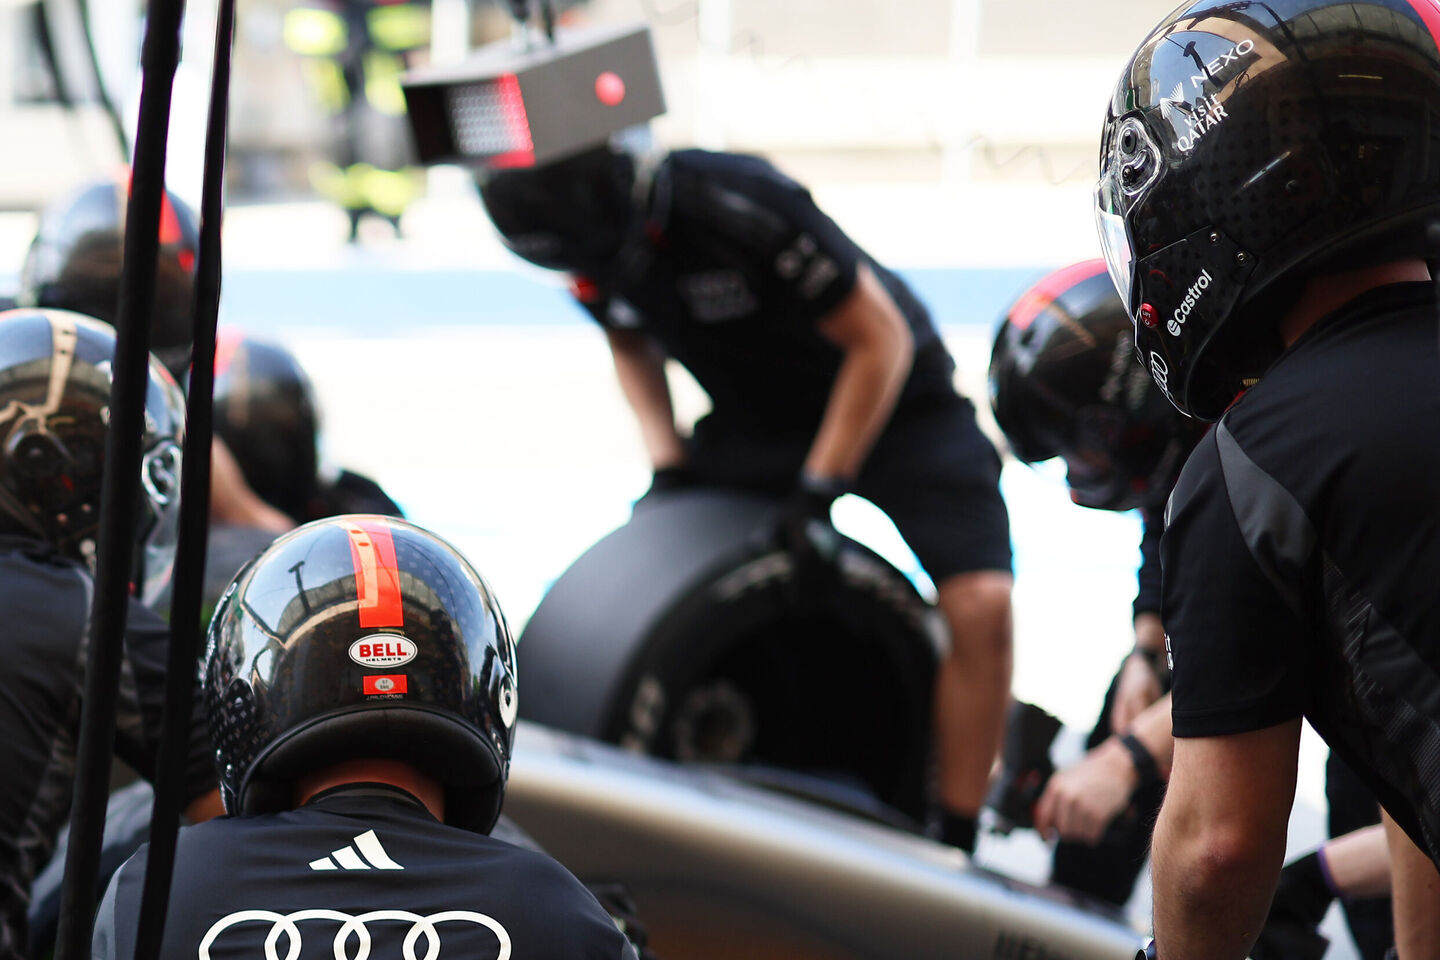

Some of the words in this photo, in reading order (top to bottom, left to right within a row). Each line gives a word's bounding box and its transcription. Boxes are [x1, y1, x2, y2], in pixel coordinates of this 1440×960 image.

[1191, 39, 1254, 88] NEXO
[1177, 105, 1228, 152] QATAR
[1184, 93, 1221, 127] visit
[1174, 268, 1213, 324] Castrol
[359, 643, 407, 657] BELL
